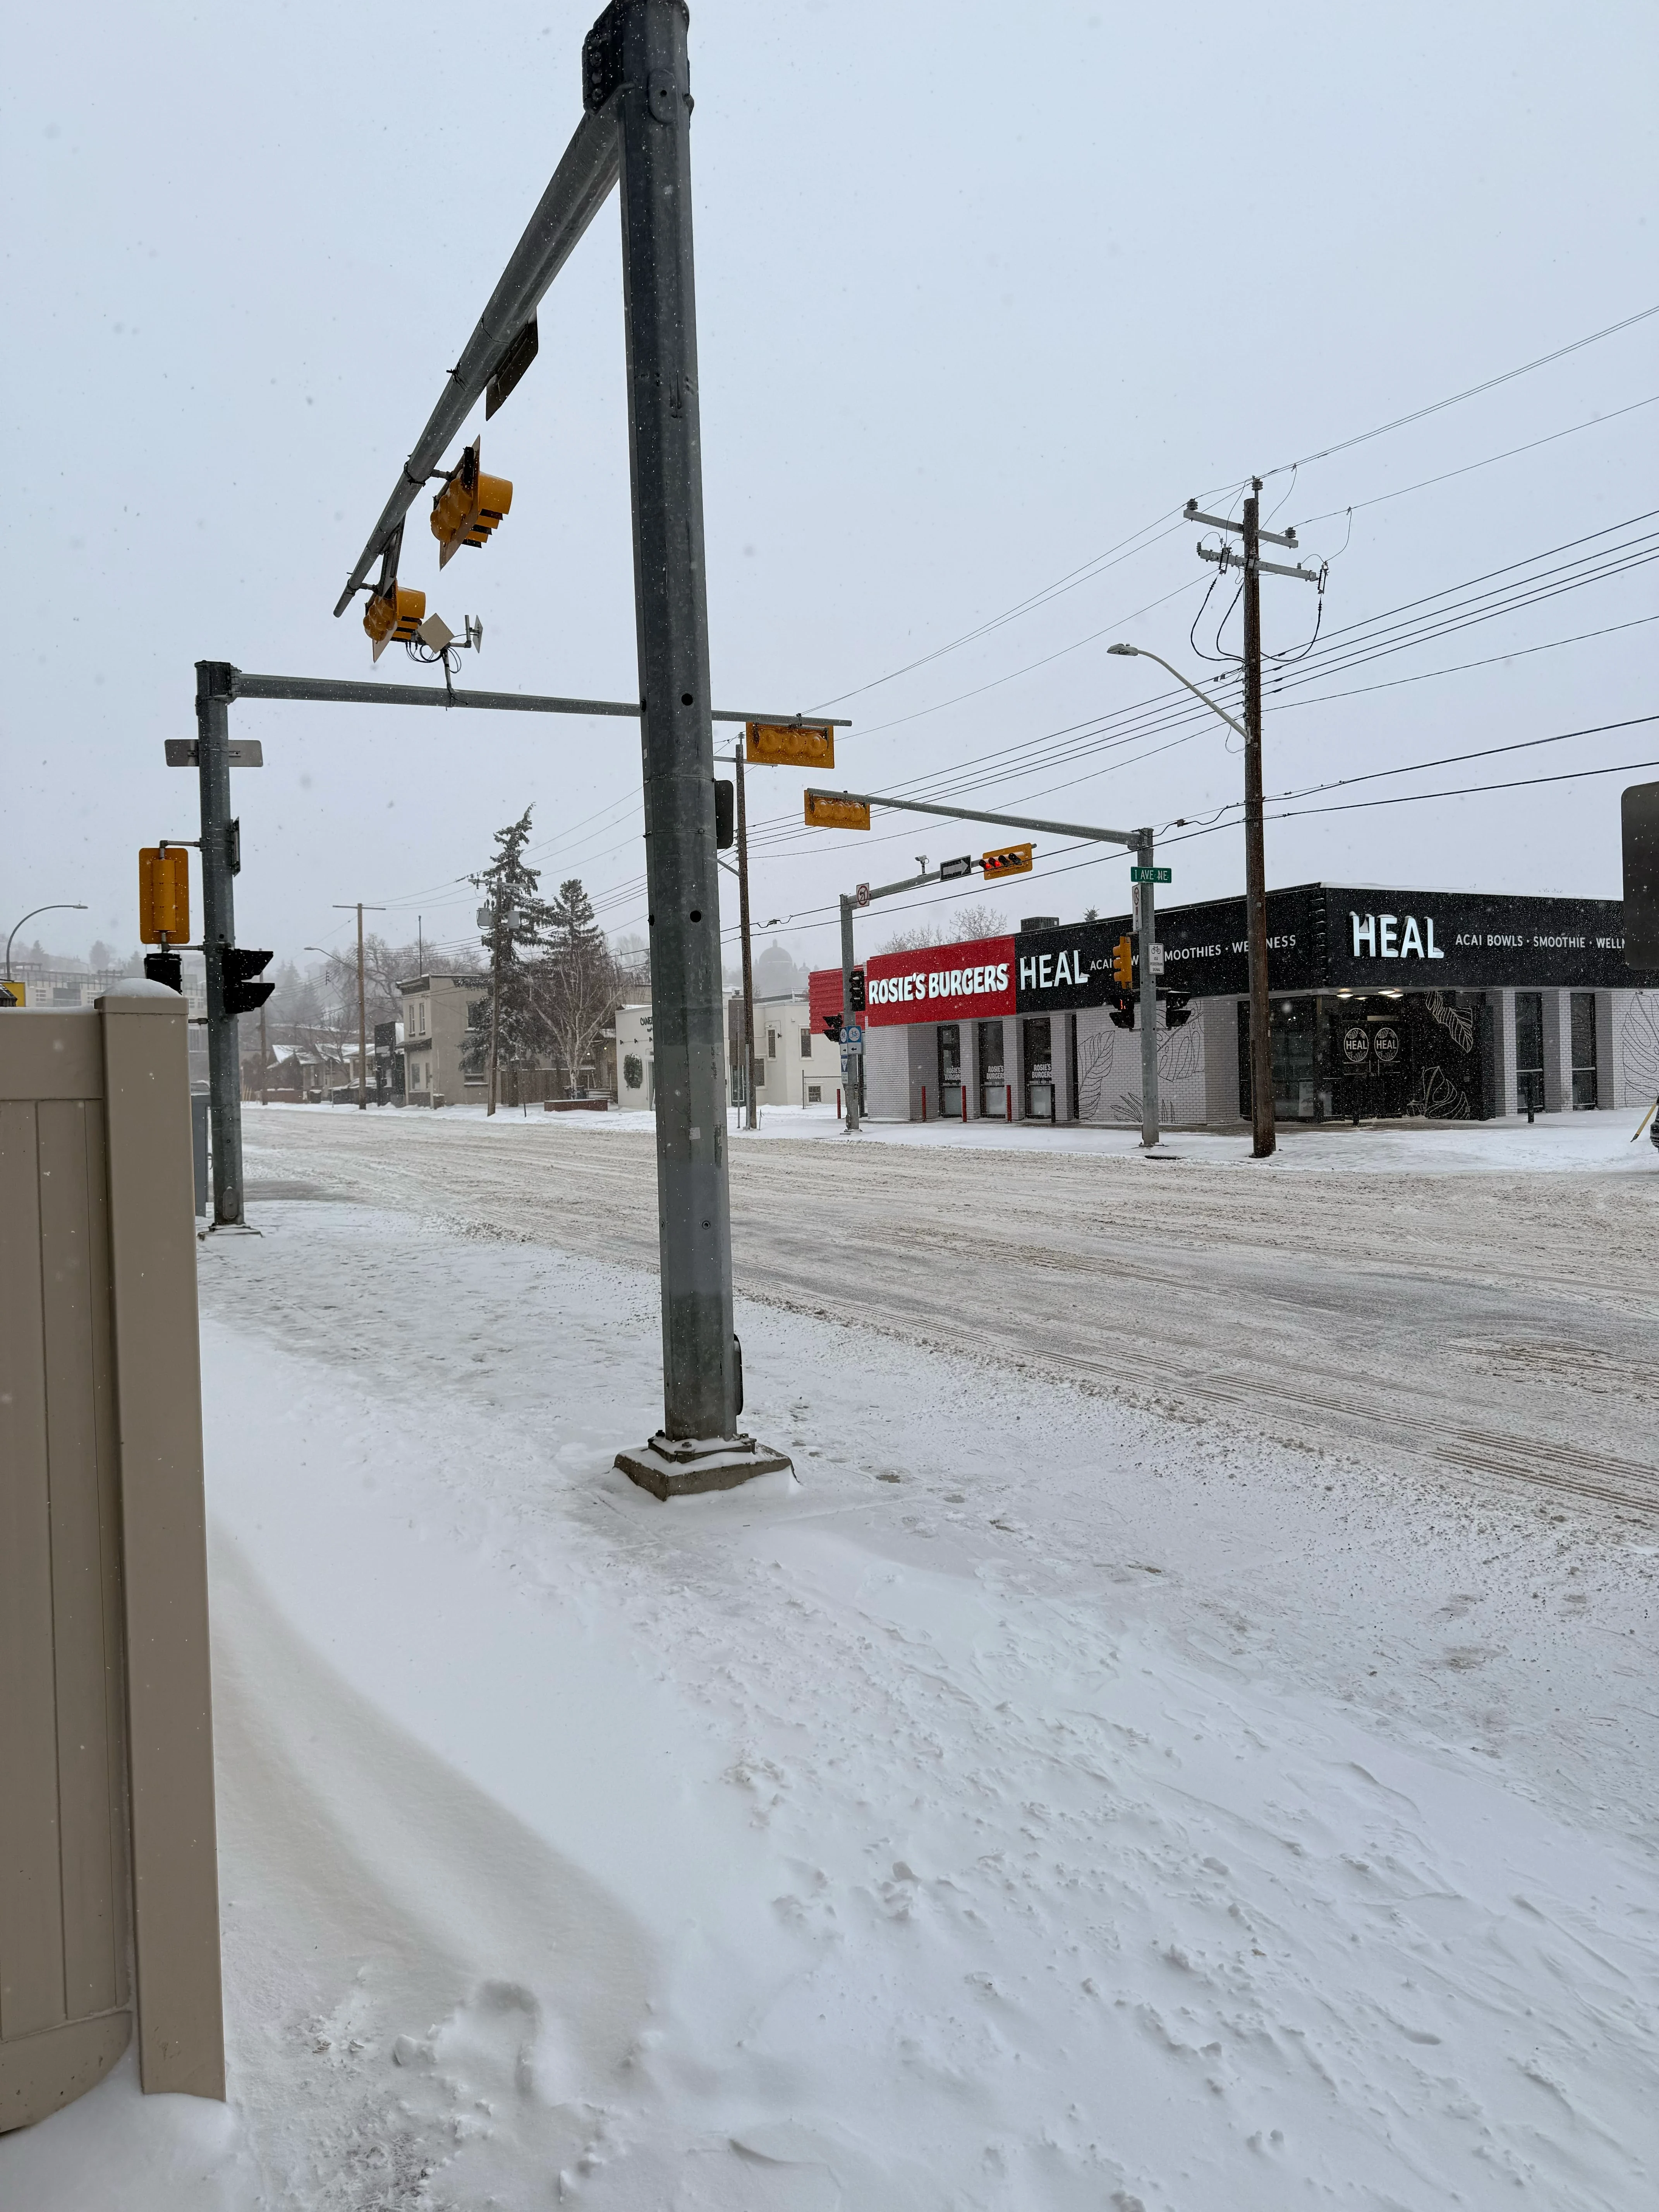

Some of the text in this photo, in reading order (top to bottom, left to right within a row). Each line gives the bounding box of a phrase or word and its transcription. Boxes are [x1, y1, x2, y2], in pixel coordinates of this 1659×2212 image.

[1135, 869, 1168, 880] 1 AVE NE
[1353, 914, 1444, 959] HEAL
[1455, 934, 1482, 945] ACAI
[1487, 935, 1523, 946] BOWLS
[1533, 936, 1585, 948] SMOOTHIE
[1090, 958, 1112, 970] ACAI
[1164, 944, 1221, 962] MOOTHIES
[1231, 934, 1296, 953] WENESS
[1020, 950, 1089, 990] HEAL
[868, 963, 1009, 1005] ROSIE'S BURGERS
[1346, 1040, 1367, 1050] HEAL
[1376, 1040, 1397, 1049] HEAL
[1034, 1063, 1051, 1072] ROSIE'S
